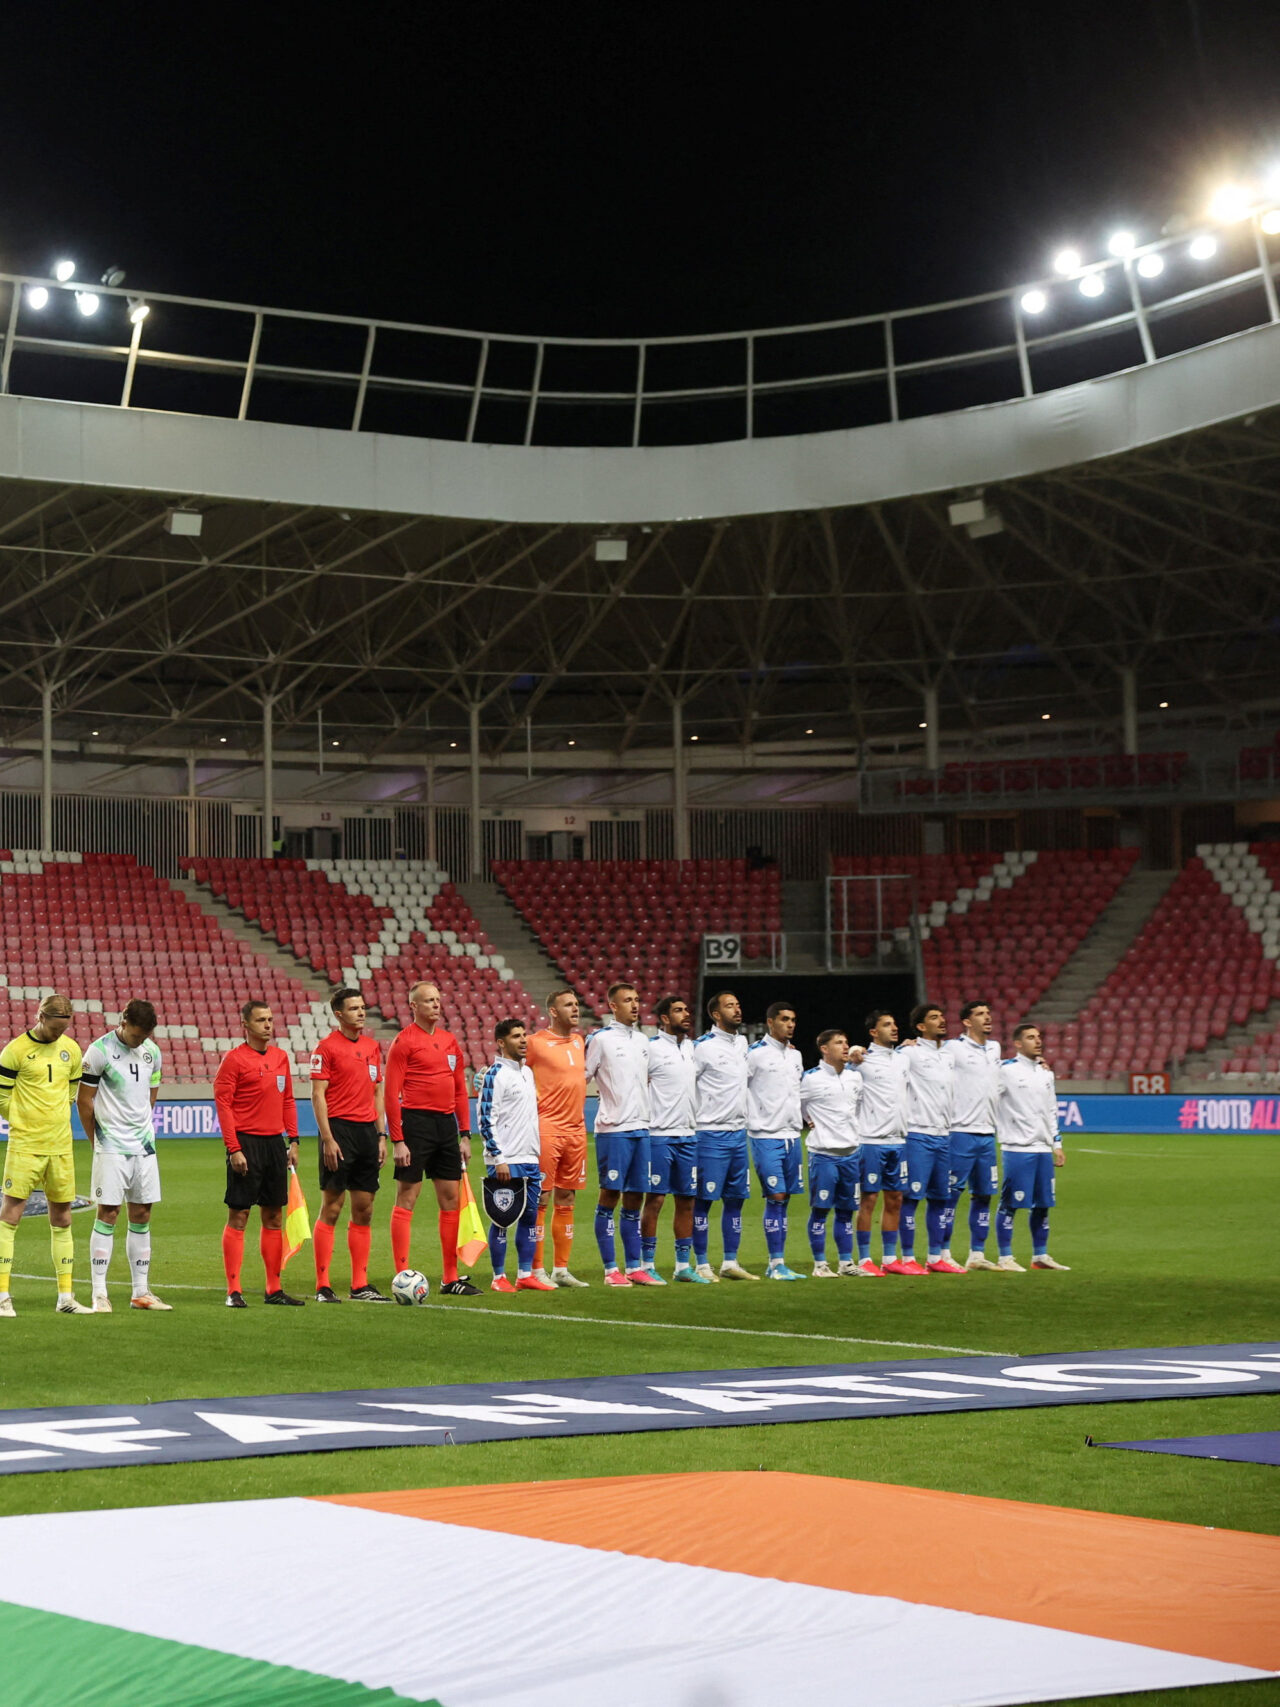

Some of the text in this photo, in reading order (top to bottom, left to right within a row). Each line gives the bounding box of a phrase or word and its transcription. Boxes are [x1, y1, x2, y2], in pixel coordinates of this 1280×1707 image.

[705, 938, 739, 960] B9
[566, 1049, 575, 1066] 1
[47, 1064, 53, 1082] 1
[129, 1063, 139, 1083] 4
[1056, 1101, 1084, 1126] FA
